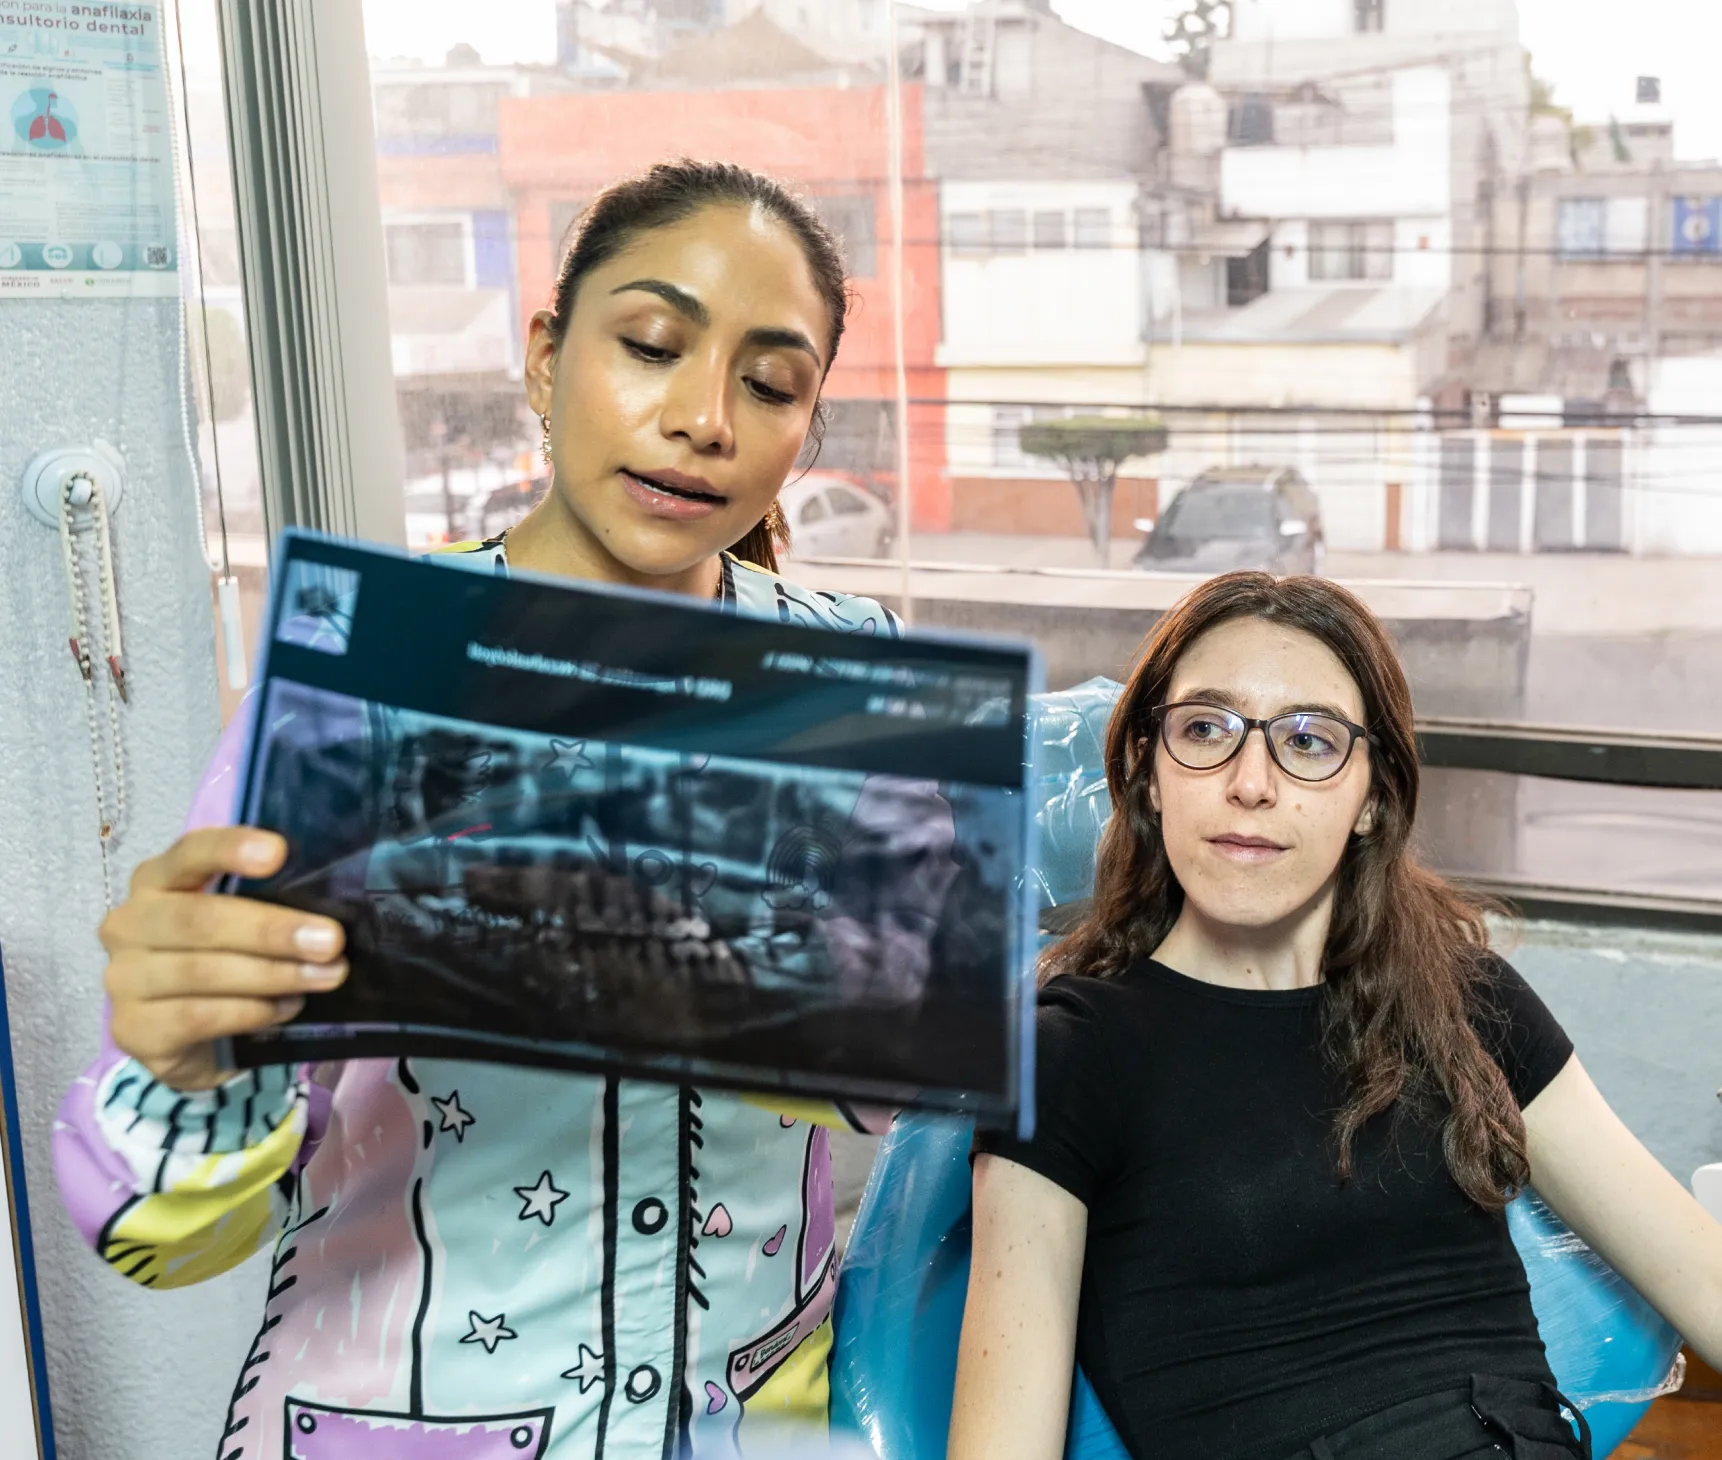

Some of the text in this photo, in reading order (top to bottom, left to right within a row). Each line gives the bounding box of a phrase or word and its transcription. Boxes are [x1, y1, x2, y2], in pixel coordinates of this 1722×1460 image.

[23, 2, 52, 13] para
[56, 4, 67, 14] la
[71, 4, 152, 22] anafilaxia
[86, 20, 145, 36] dental
